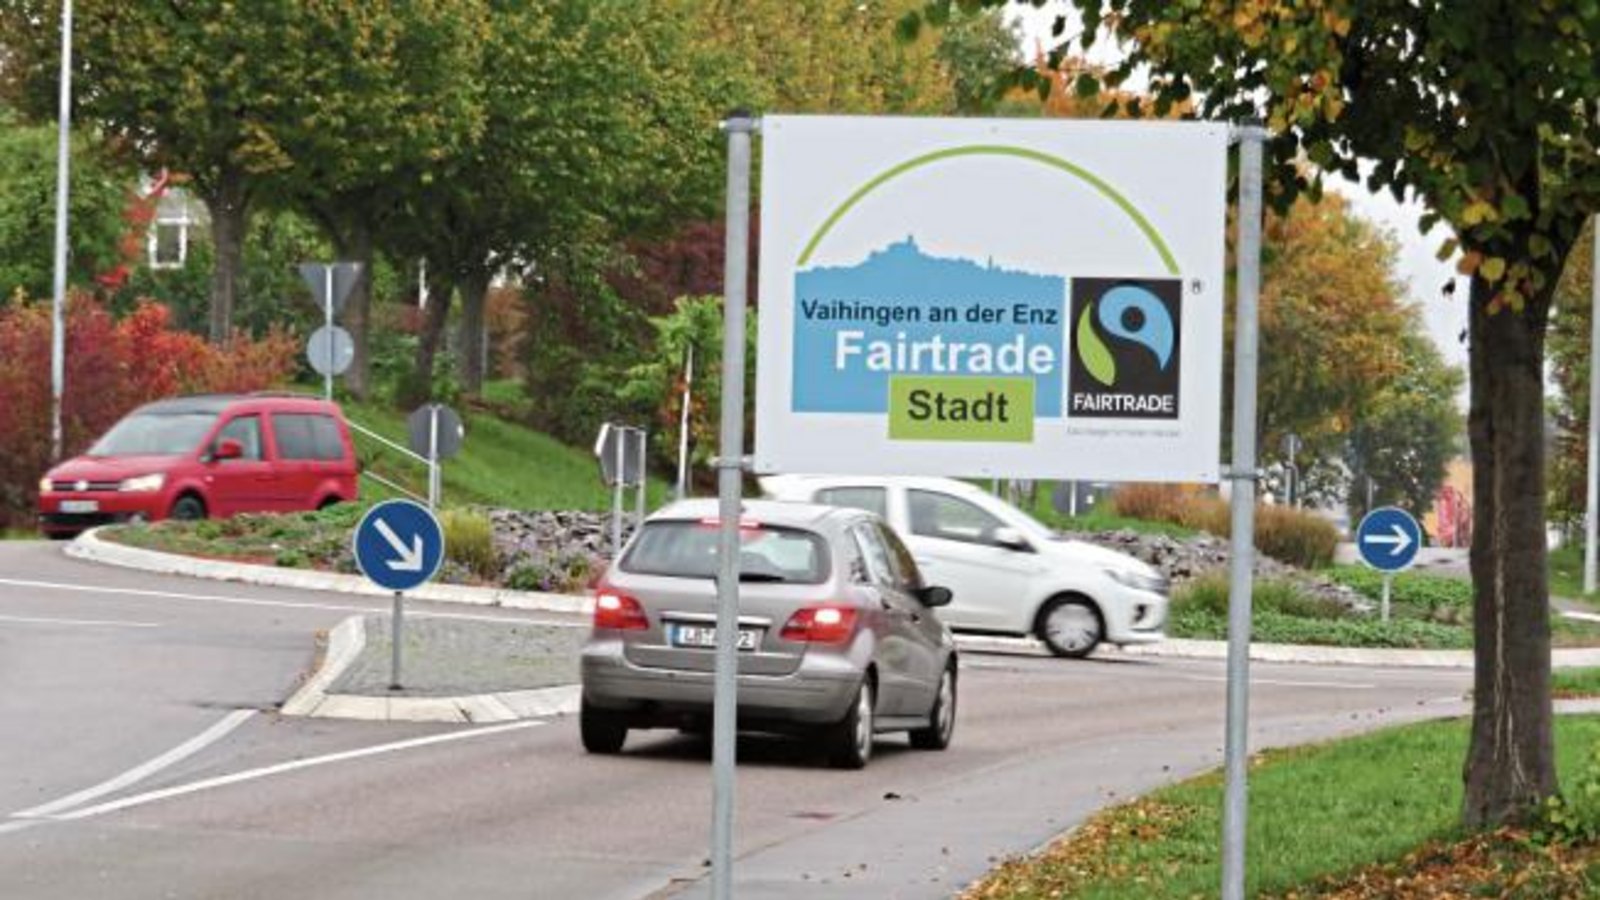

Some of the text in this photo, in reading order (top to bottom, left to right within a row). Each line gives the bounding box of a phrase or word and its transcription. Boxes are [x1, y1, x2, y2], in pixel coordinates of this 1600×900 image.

[801, 300, 1059, 326] Vaihingen an der Enz
[835, 330, 1056, 374] Fairtrade
[907, 389, 1010, 423] Stadt
[1073, 392, 1175, 413] FAIRTRADE
